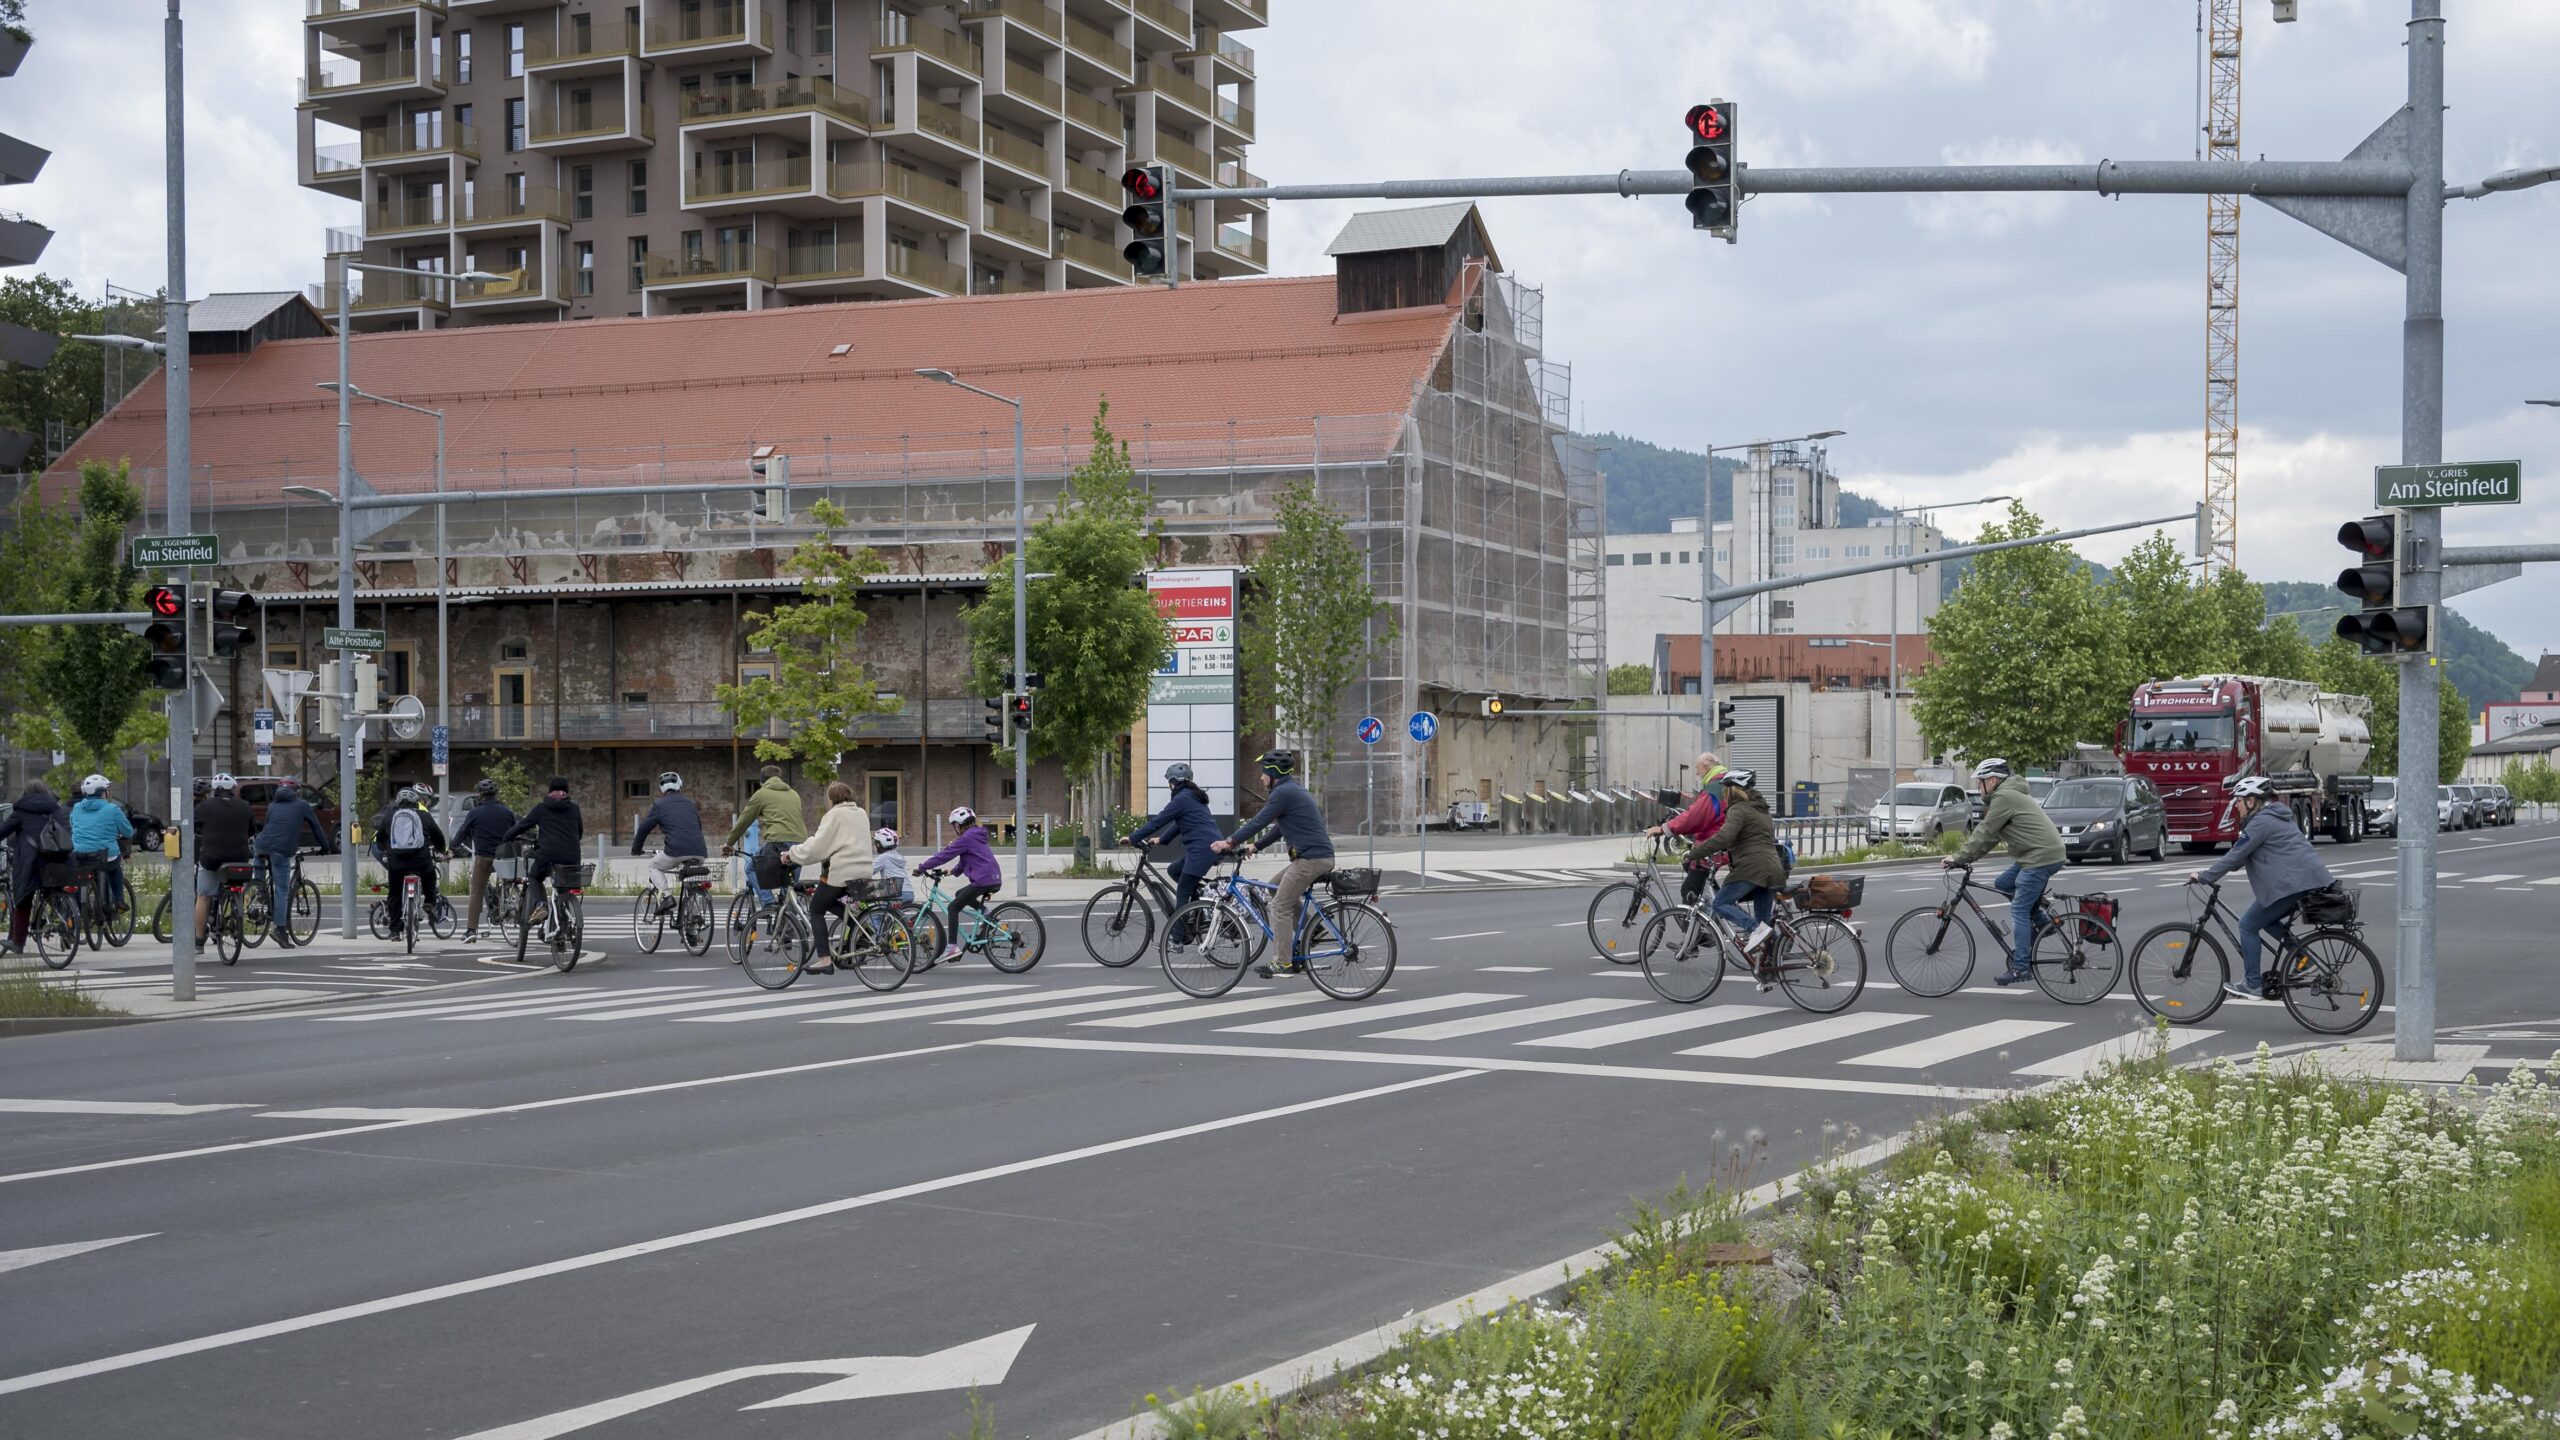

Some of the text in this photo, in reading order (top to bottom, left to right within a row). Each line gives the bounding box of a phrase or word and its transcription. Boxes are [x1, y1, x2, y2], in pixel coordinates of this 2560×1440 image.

[2440, 468, 2468, 478] GRIES
[2388, 478, 2508, 499] Am Steinfeld
[164, 539, 200, 547] EGGENBERG
[140, 546, 212, 561] Am Steinfeld
[329, 636, 382, 648] Alte Poststraße
[2150, 697, 2213, 705] STROHMEIER
[2147, 762, 2210, 771] VOLVO
